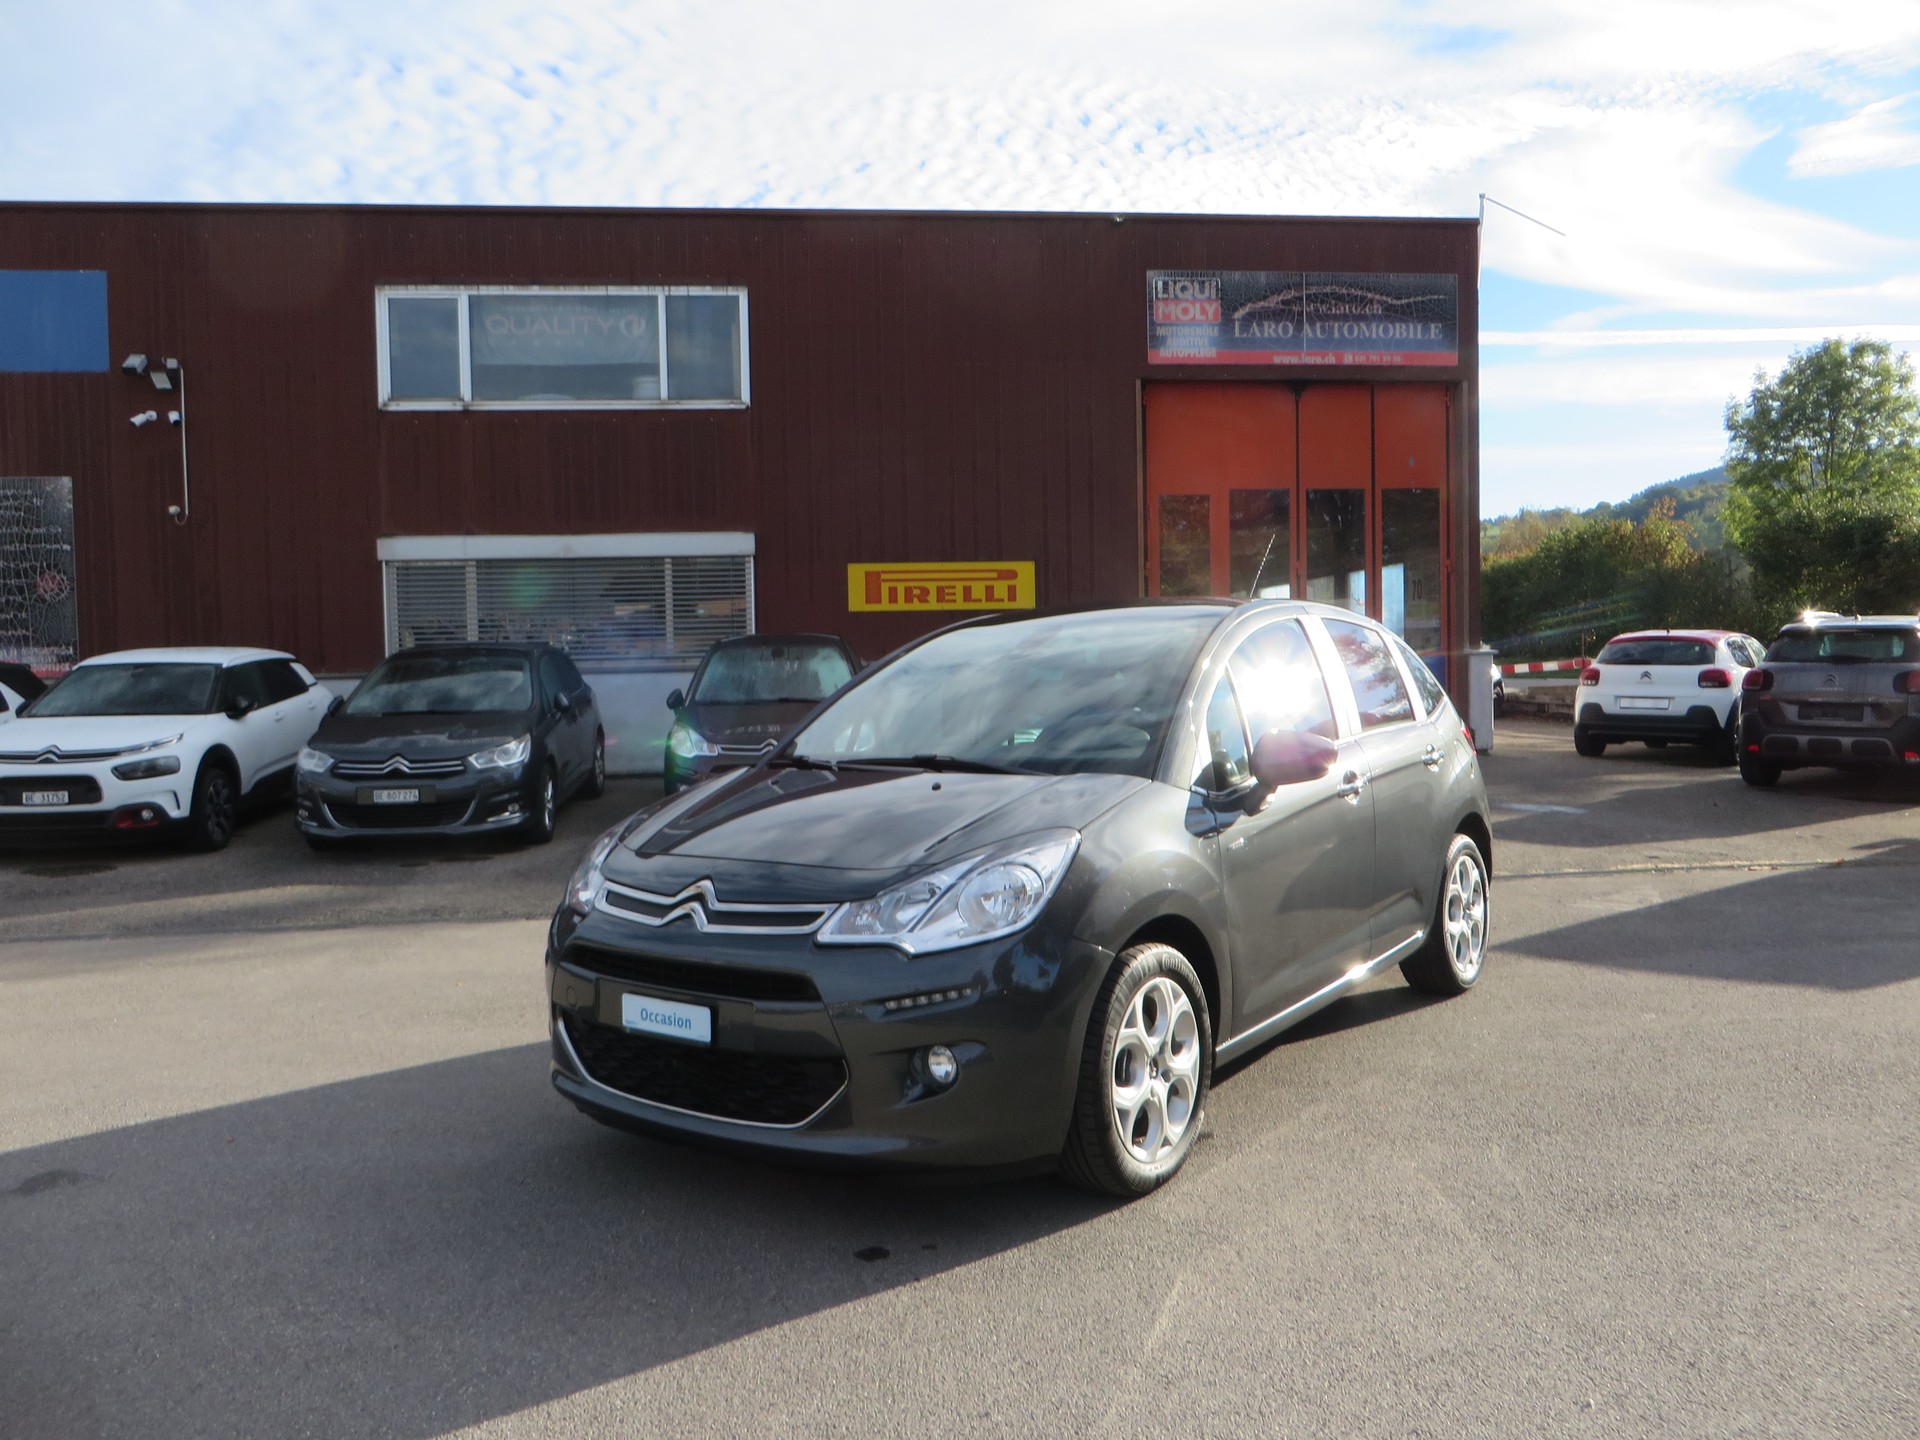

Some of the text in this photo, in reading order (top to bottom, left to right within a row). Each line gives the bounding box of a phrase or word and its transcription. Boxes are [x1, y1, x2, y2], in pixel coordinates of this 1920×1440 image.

[1157, 280, 1217, 299] LIQUI
[1158, 302, 1217, 320] MOLY
[485, 315, 616, 335] QUALITY
[1234, 320, 1443, 339] LARO AUTOMOBILE
[865, 569, 1018, 604] PIRELLI
[640, 1008, 692, 1030] Occasion
